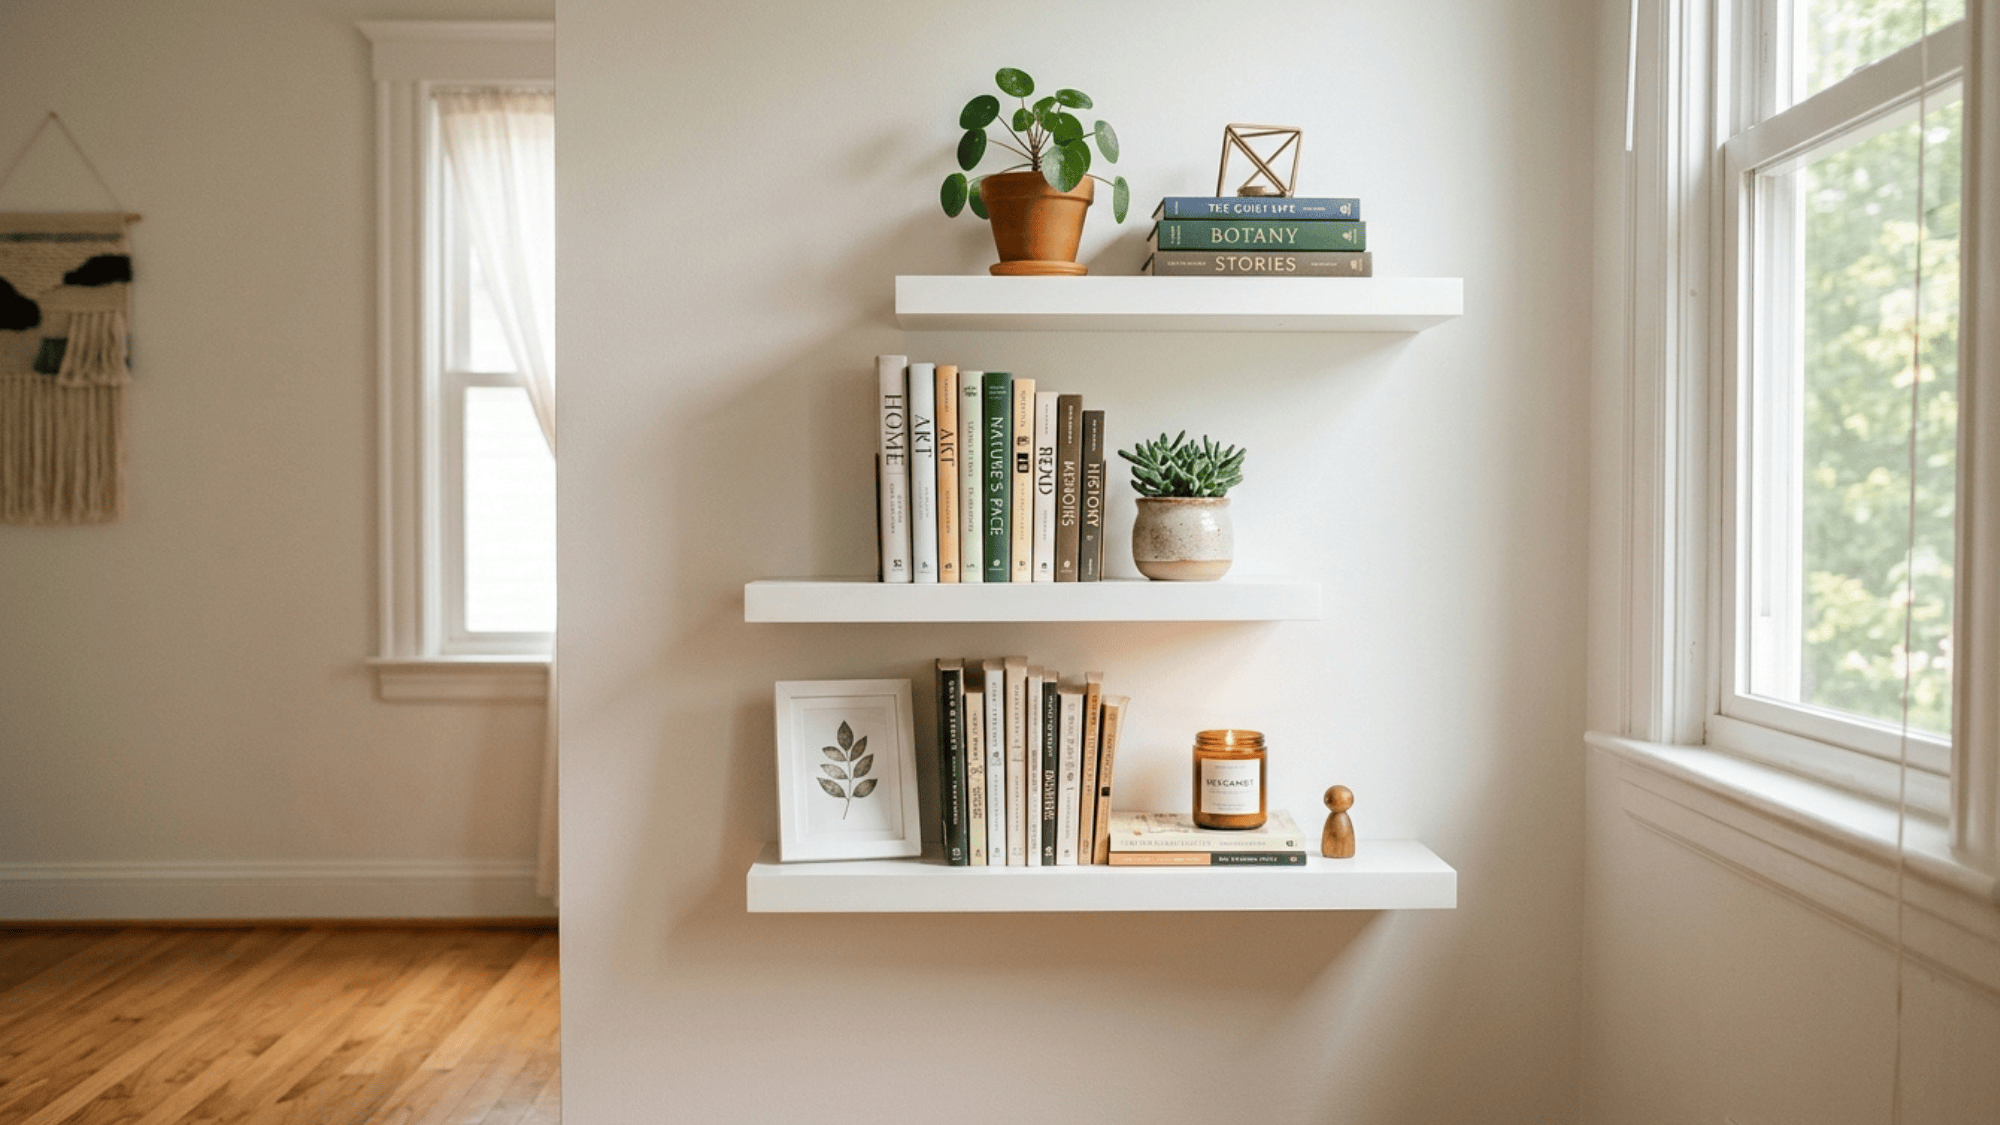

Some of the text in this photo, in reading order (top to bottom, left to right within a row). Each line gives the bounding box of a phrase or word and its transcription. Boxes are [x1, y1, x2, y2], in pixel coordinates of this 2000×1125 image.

[1208, 203, 1229, 214] THE
[1271, 203, 1296, 214] LIFE
[1211, 227, 1299, 244] BOTANY
[1215, 256, 1297, 272] STORIES
[884, 394, 905, 466] HOME
[914, 414, 932, 458] ART
[1086, 463, 1101, 528] HISTORY
[989, 497, 1004, 536] PACE
